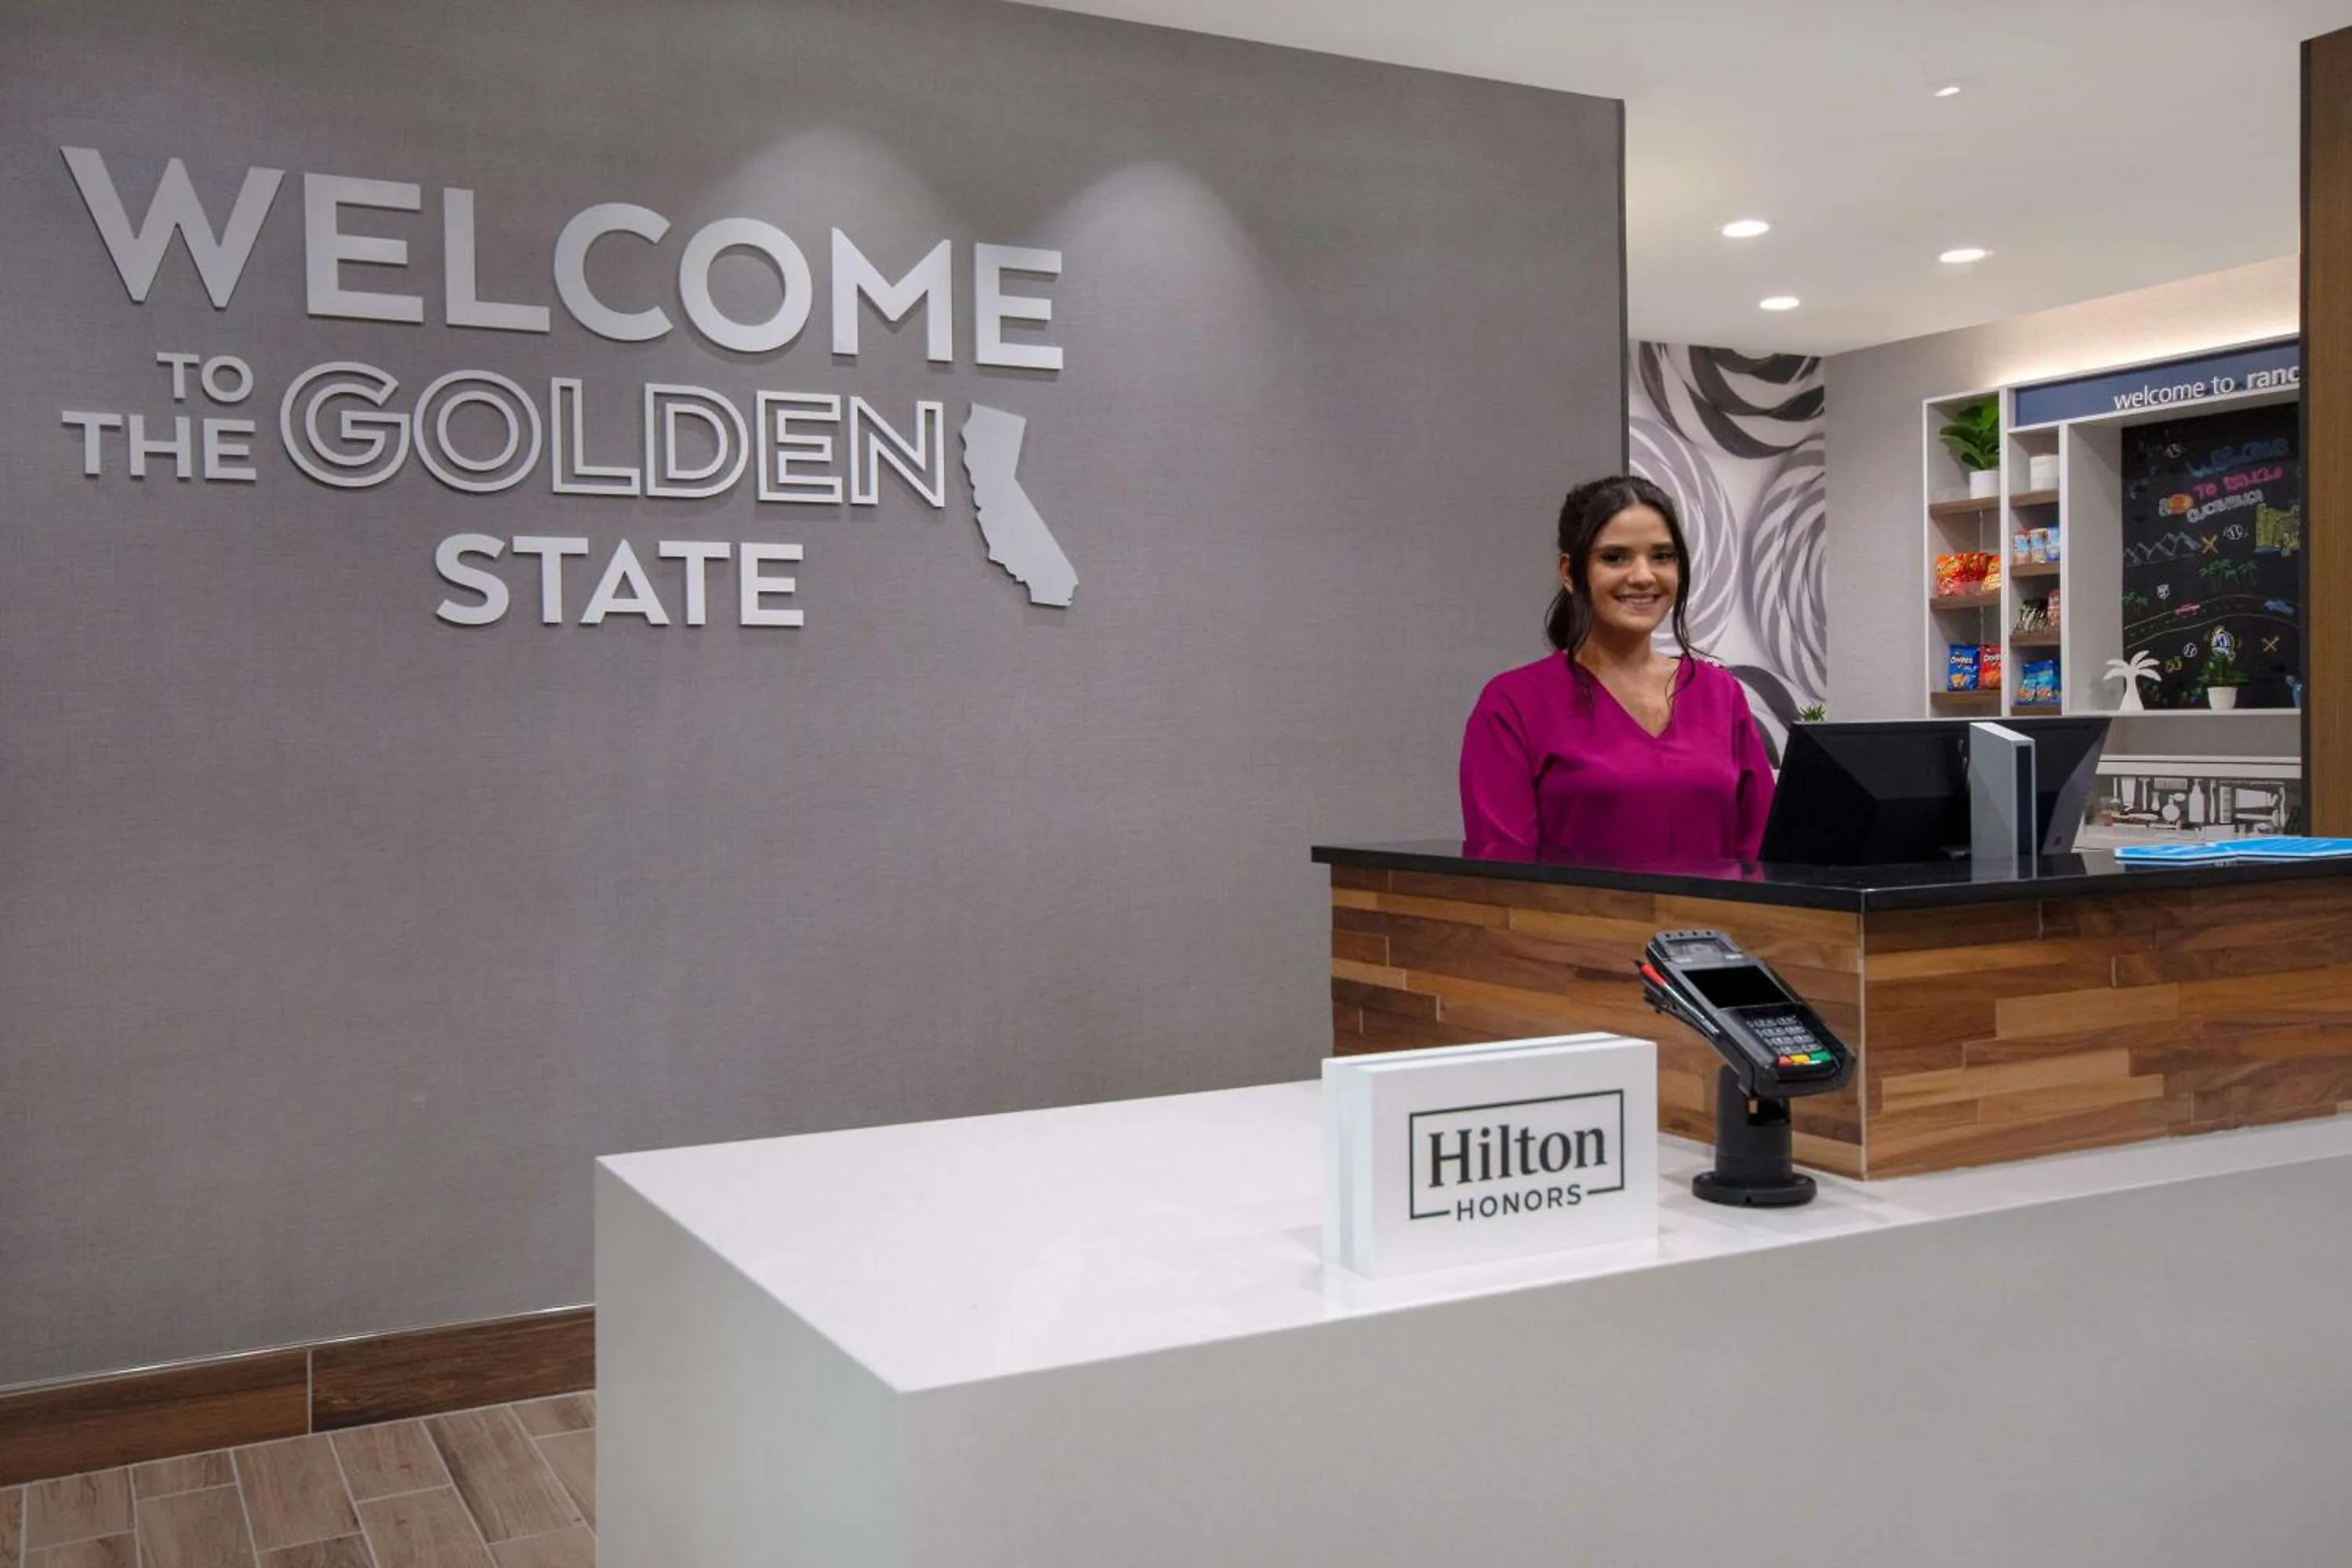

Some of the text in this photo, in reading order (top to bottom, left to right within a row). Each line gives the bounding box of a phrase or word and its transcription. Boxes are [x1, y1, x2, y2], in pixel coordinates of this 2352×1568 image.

[60, 145, 1064, 370] WELCOME
[156, 351, 254, 402] TO
[2113, 382, 2205, 410] welcome
[2211, 376, 2234, 395] to
[61, 361, 946, 508] THE GOLDEN
[434, 532, 804, 627] STATE
[1428, 1123, 1608, 1188] Hilton
[1457, 1184, 1582, 1221] HONORS
